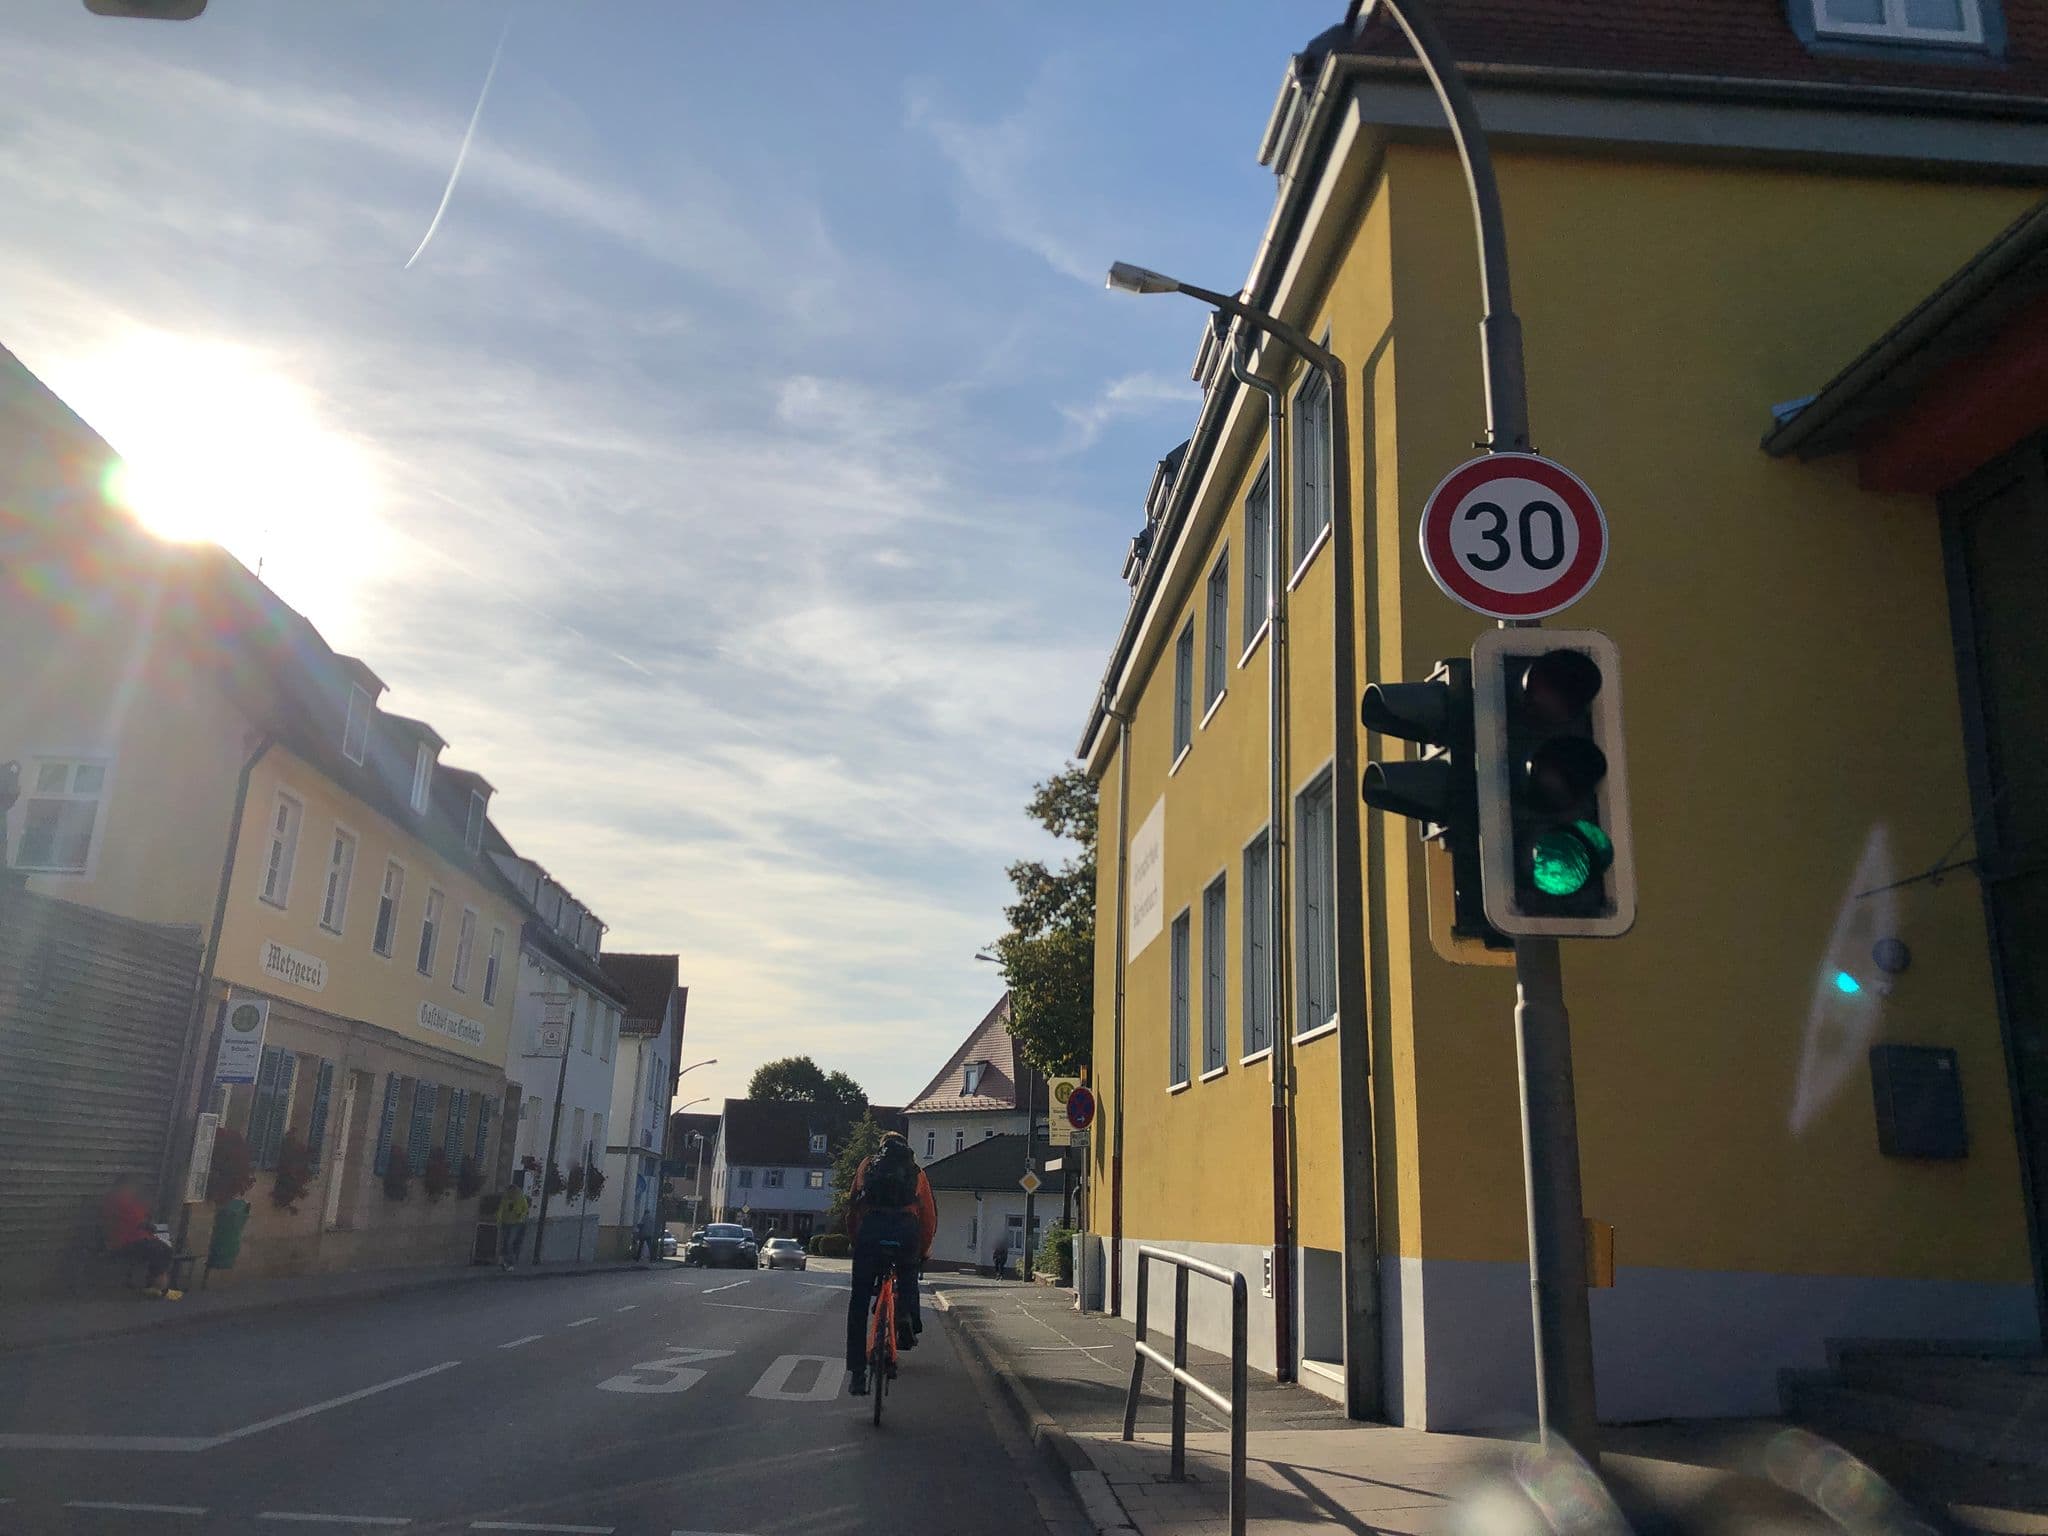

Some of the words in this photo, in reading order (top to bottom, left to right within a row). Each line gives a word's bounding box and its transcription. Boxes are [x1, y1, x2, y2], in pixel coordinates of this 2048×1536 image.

[1464, 500, 1565, 571] 30
[266, 943, 321, 986] Metzgerei
[595, 1346, 847, 1401] 30
